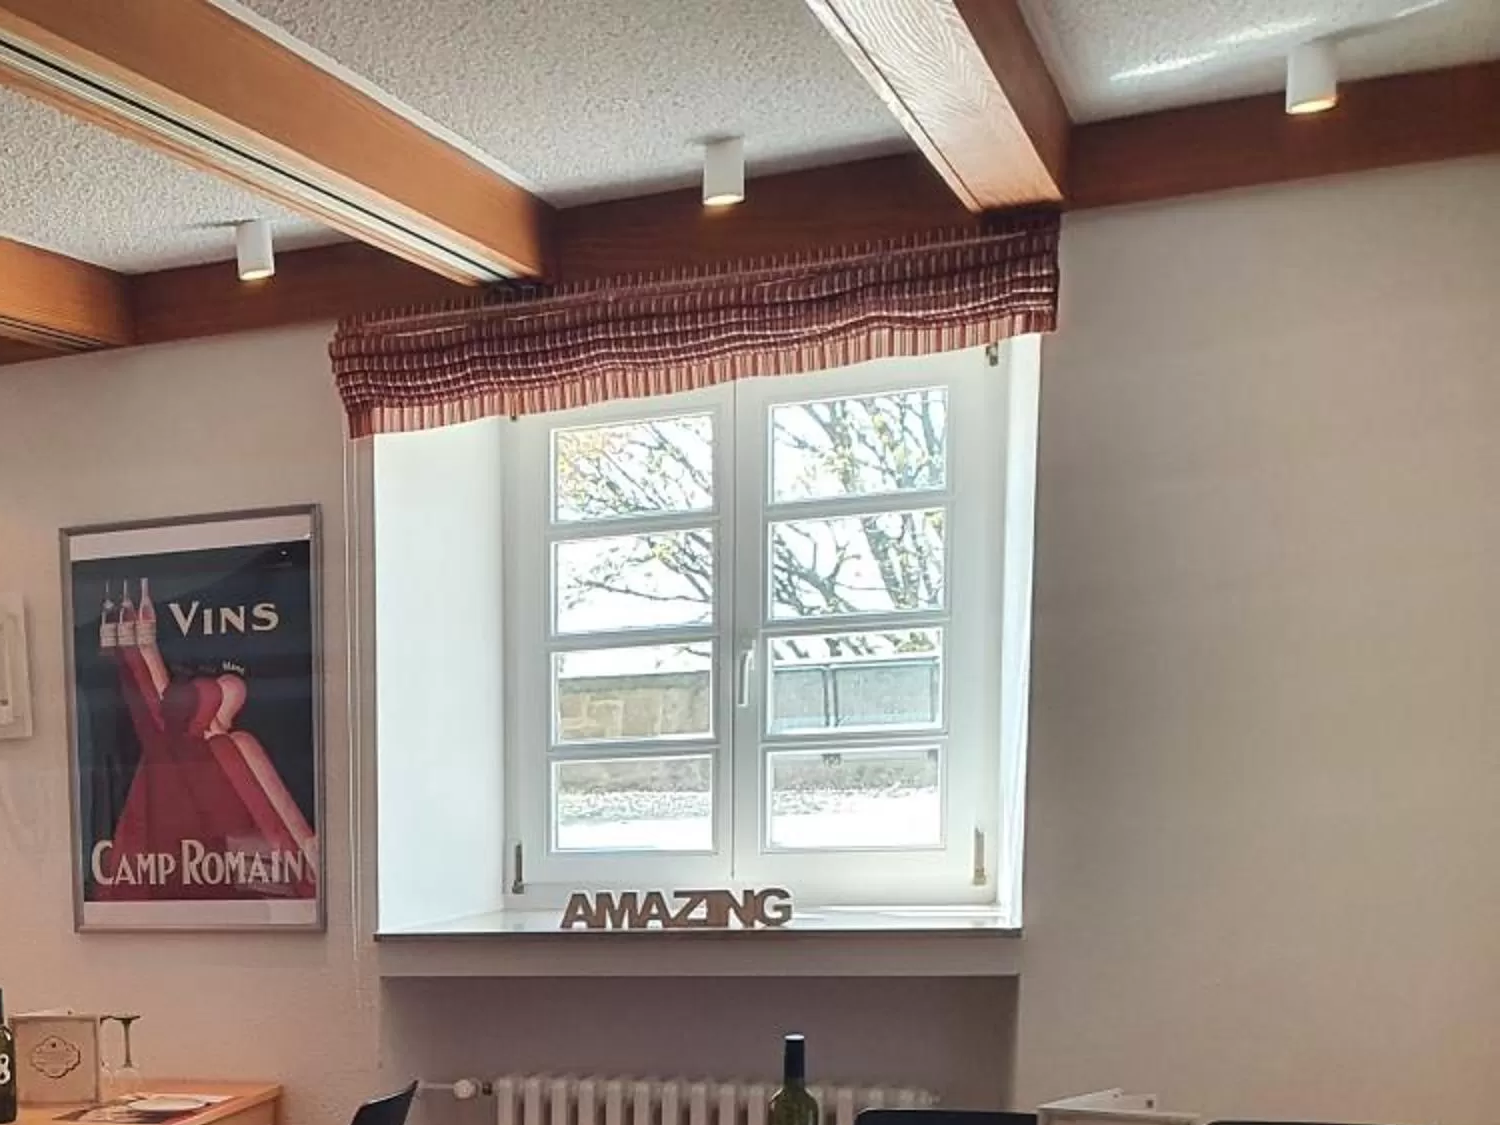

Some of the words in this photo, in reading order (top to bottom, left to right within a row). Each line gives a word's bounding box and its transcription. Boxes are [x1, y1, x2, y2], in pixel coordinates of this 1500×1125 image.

[168, 601, 279, 637] VINS
[91, 839, 176, 885] CAMP
[181, 839, 304, 886] ROMAIN
[560, 888, 792, 929] AMAZING
